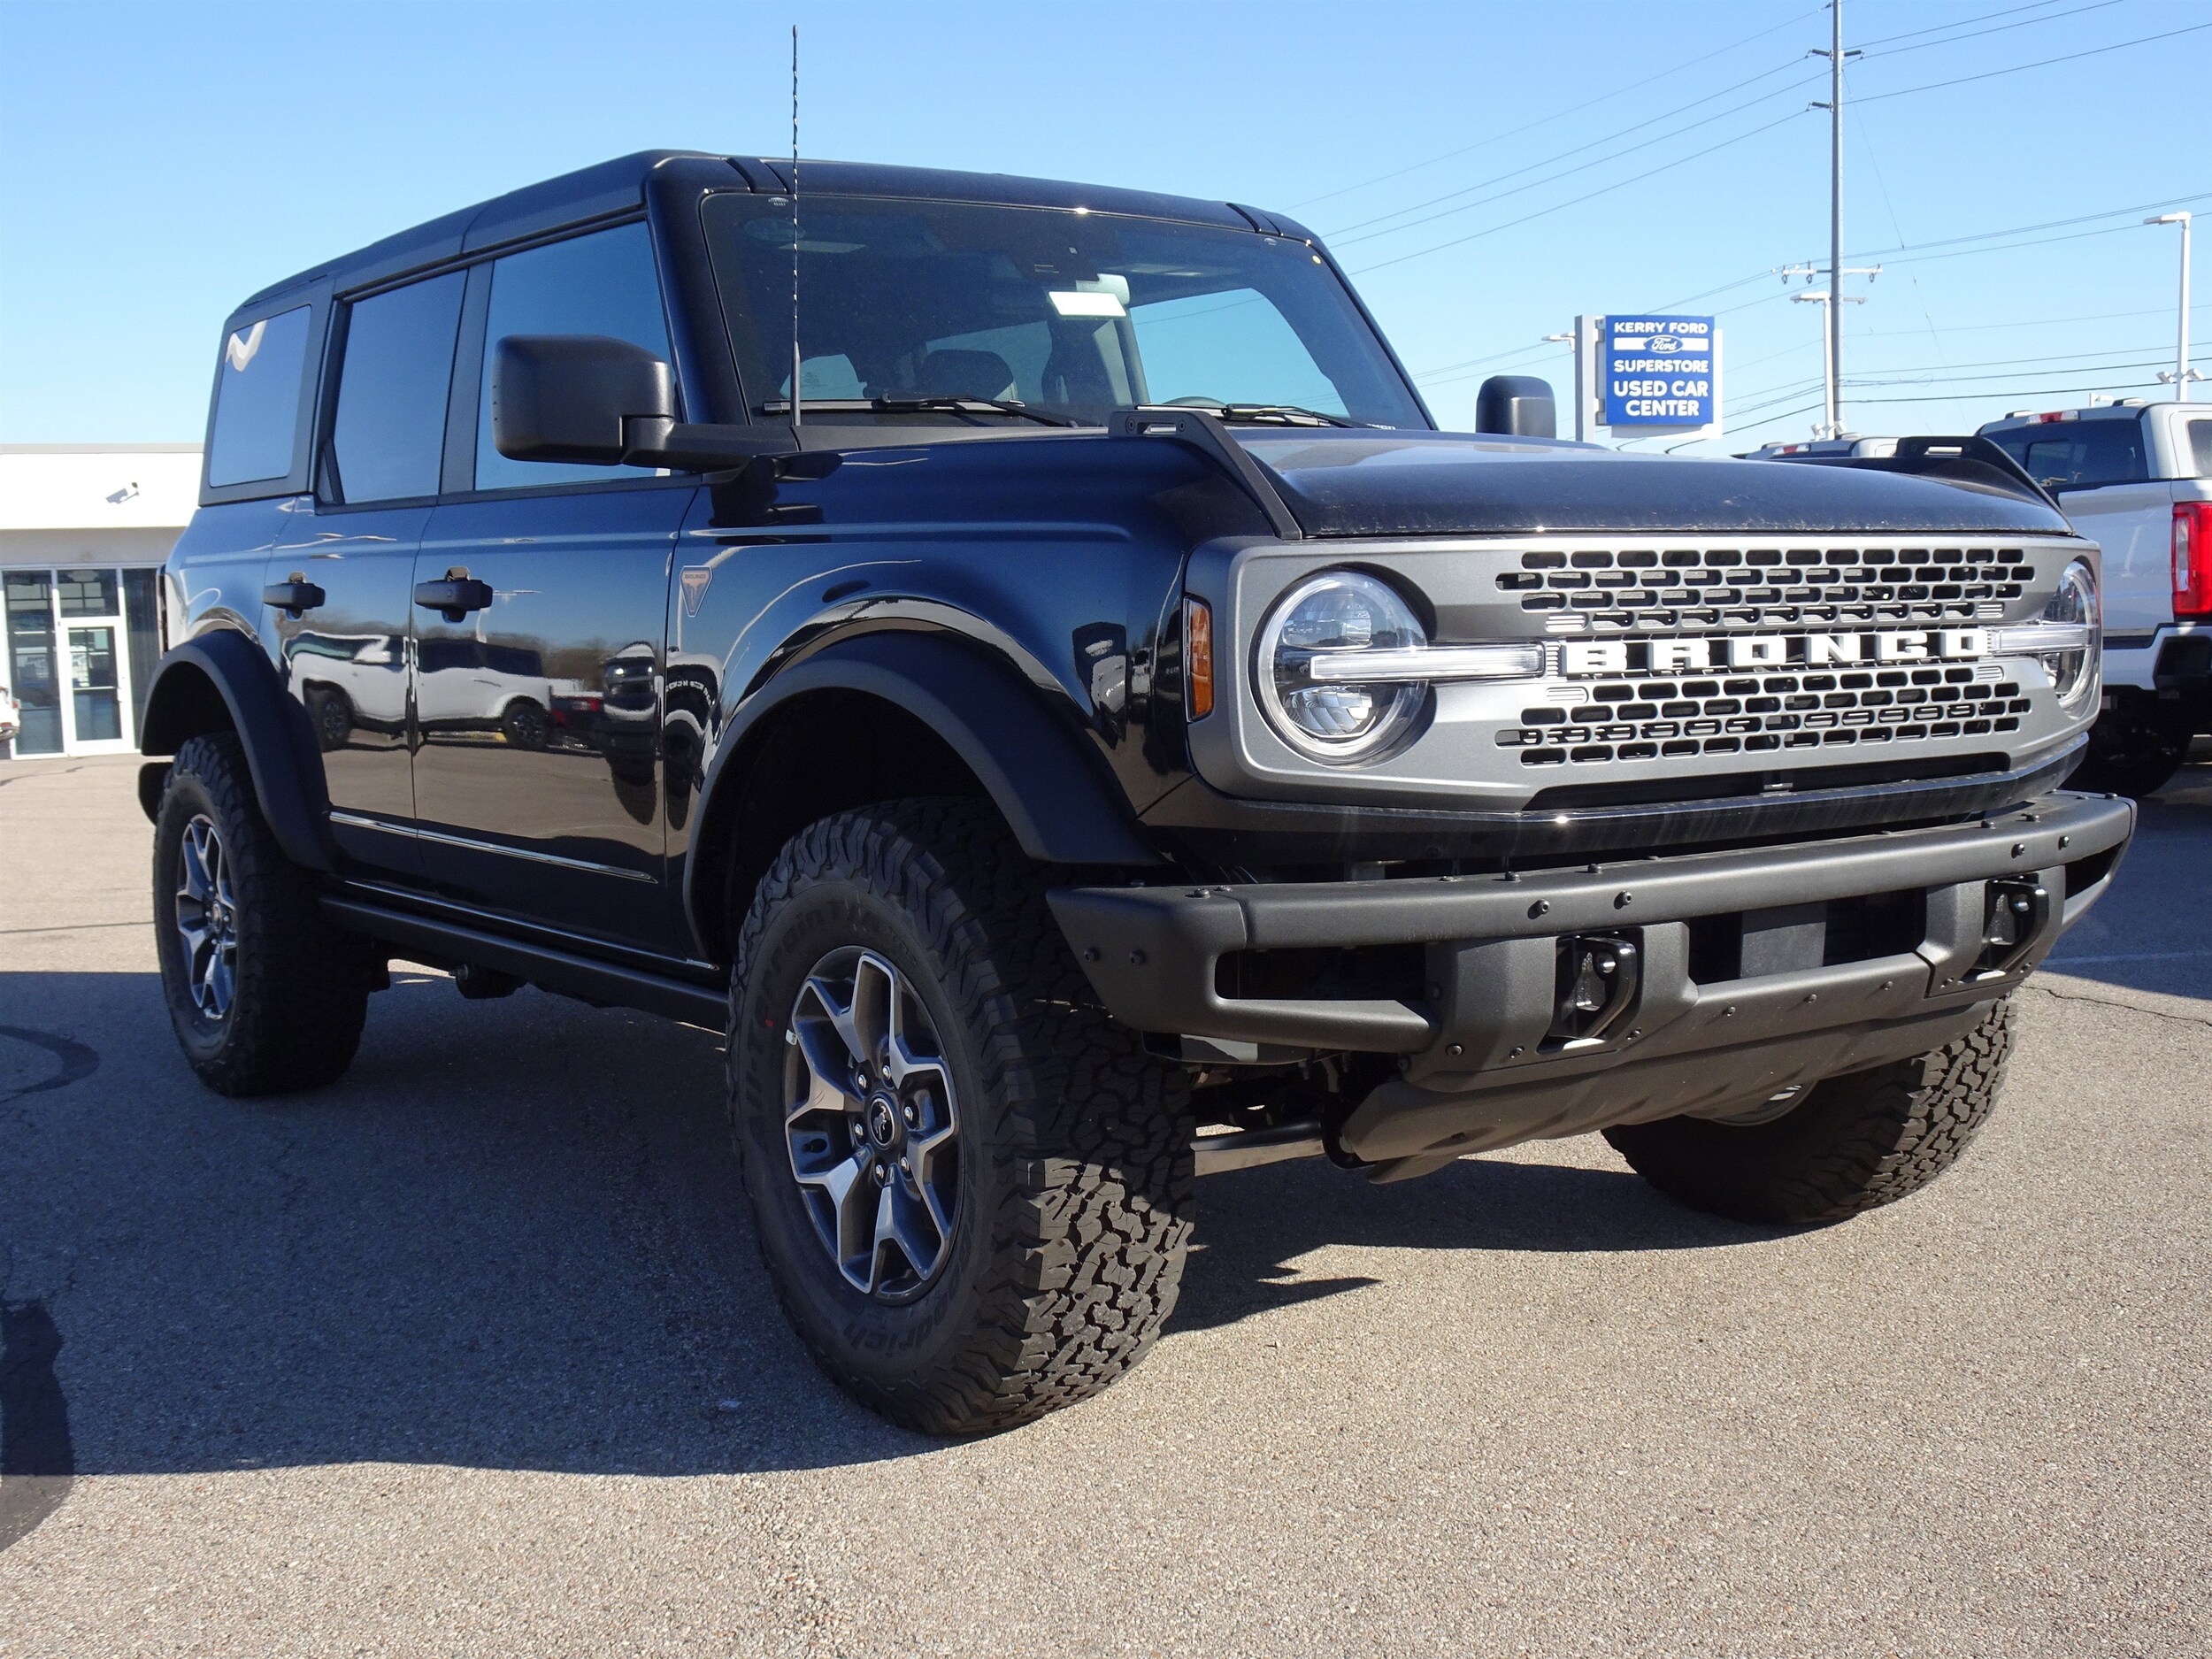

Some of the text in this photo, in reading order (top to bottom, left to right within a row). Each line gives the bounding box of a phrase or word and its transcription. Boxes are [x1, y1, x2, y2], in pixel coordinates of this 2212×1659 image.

[1614, 321, 1709, 334] KERRY FORD
[1651, 337, 1678, 351] Ford
[1614, 359, 1709, 373] SUPERSTORE
[1614, 380, 1709, 397] USED CAR
[1625, 400, 1699, 417] CENTER
[1560, 628, 1988, 677] BRONCO
